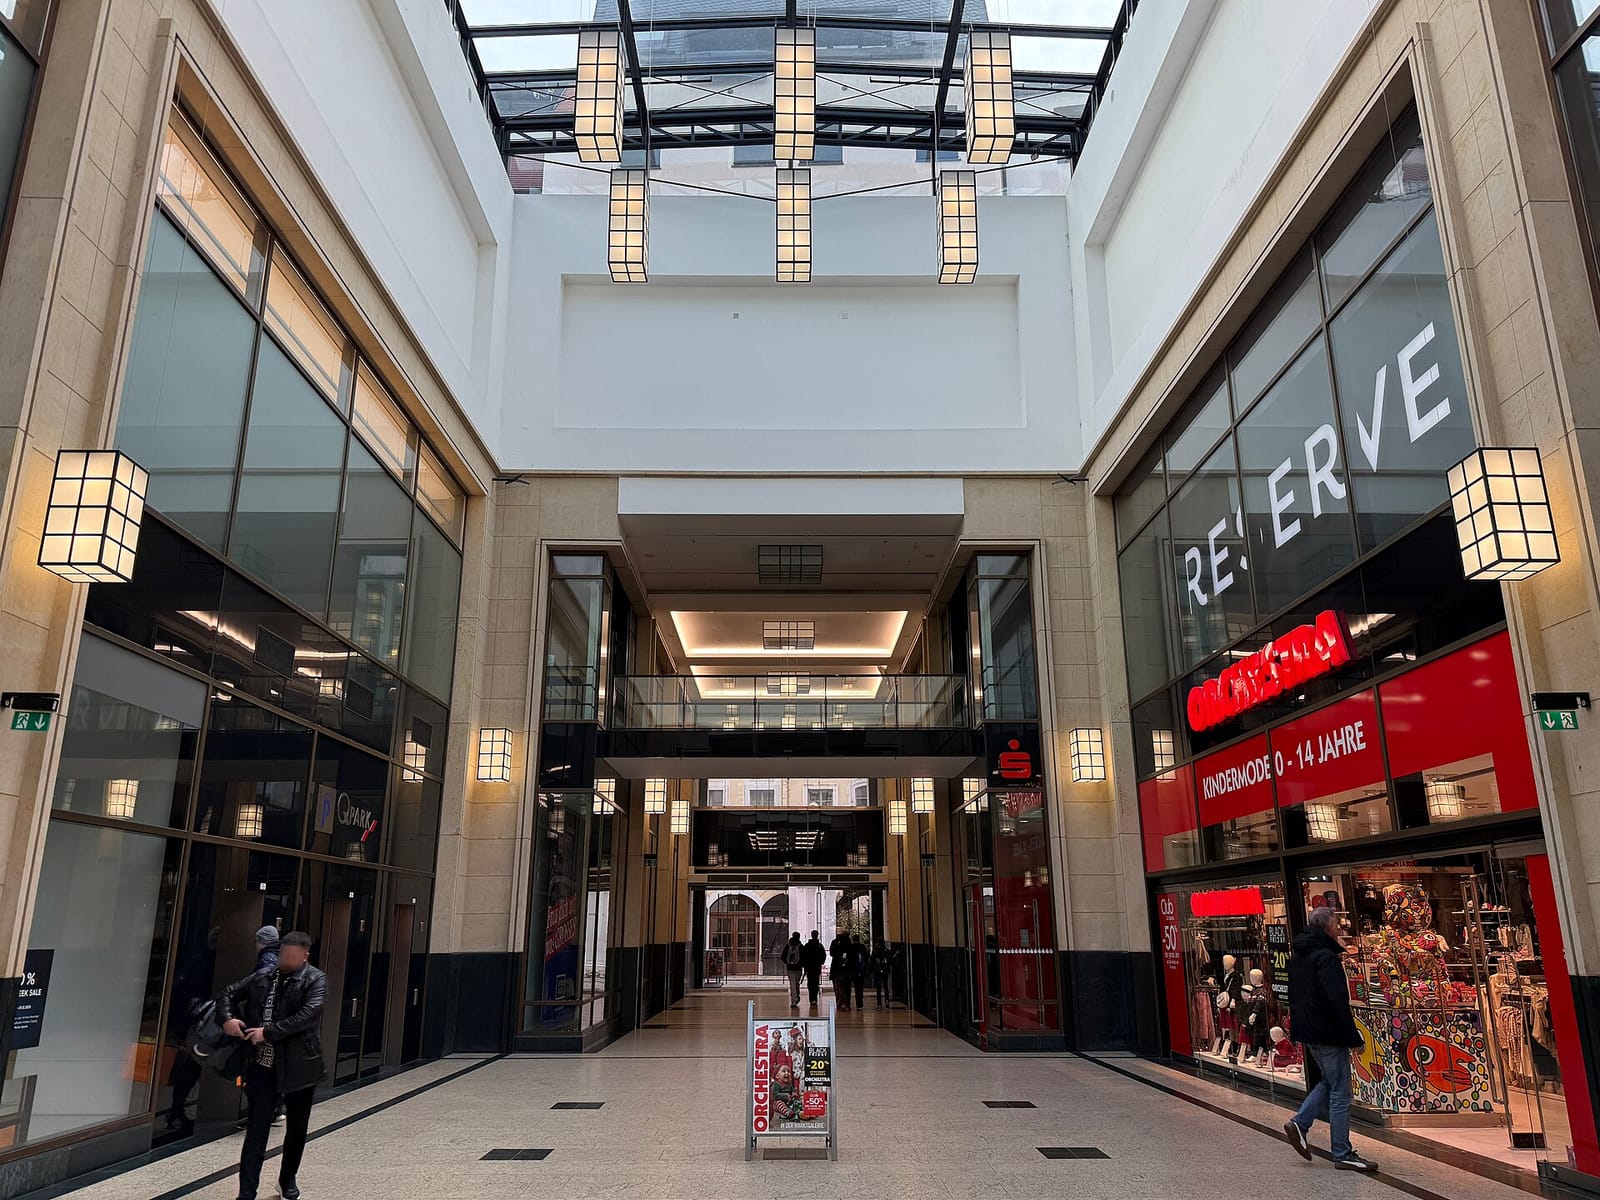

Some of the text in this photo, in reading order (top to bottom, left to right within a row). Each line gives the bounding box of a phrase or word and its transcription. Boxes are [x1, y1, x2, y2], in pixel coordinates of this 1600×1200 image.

[1202, 754, 1271, 800] KINDERMODE
[1274, 750, 1284, 777] 0
[1296, 739, 1314, 770] 14
[1318, 720, 1367, 764] JAHRE
[1268, 926, 1285, 937] BLACK
[29, 988, 42, 996] SALE
[753, 1024, 769, 1132] ORCHESTRA
